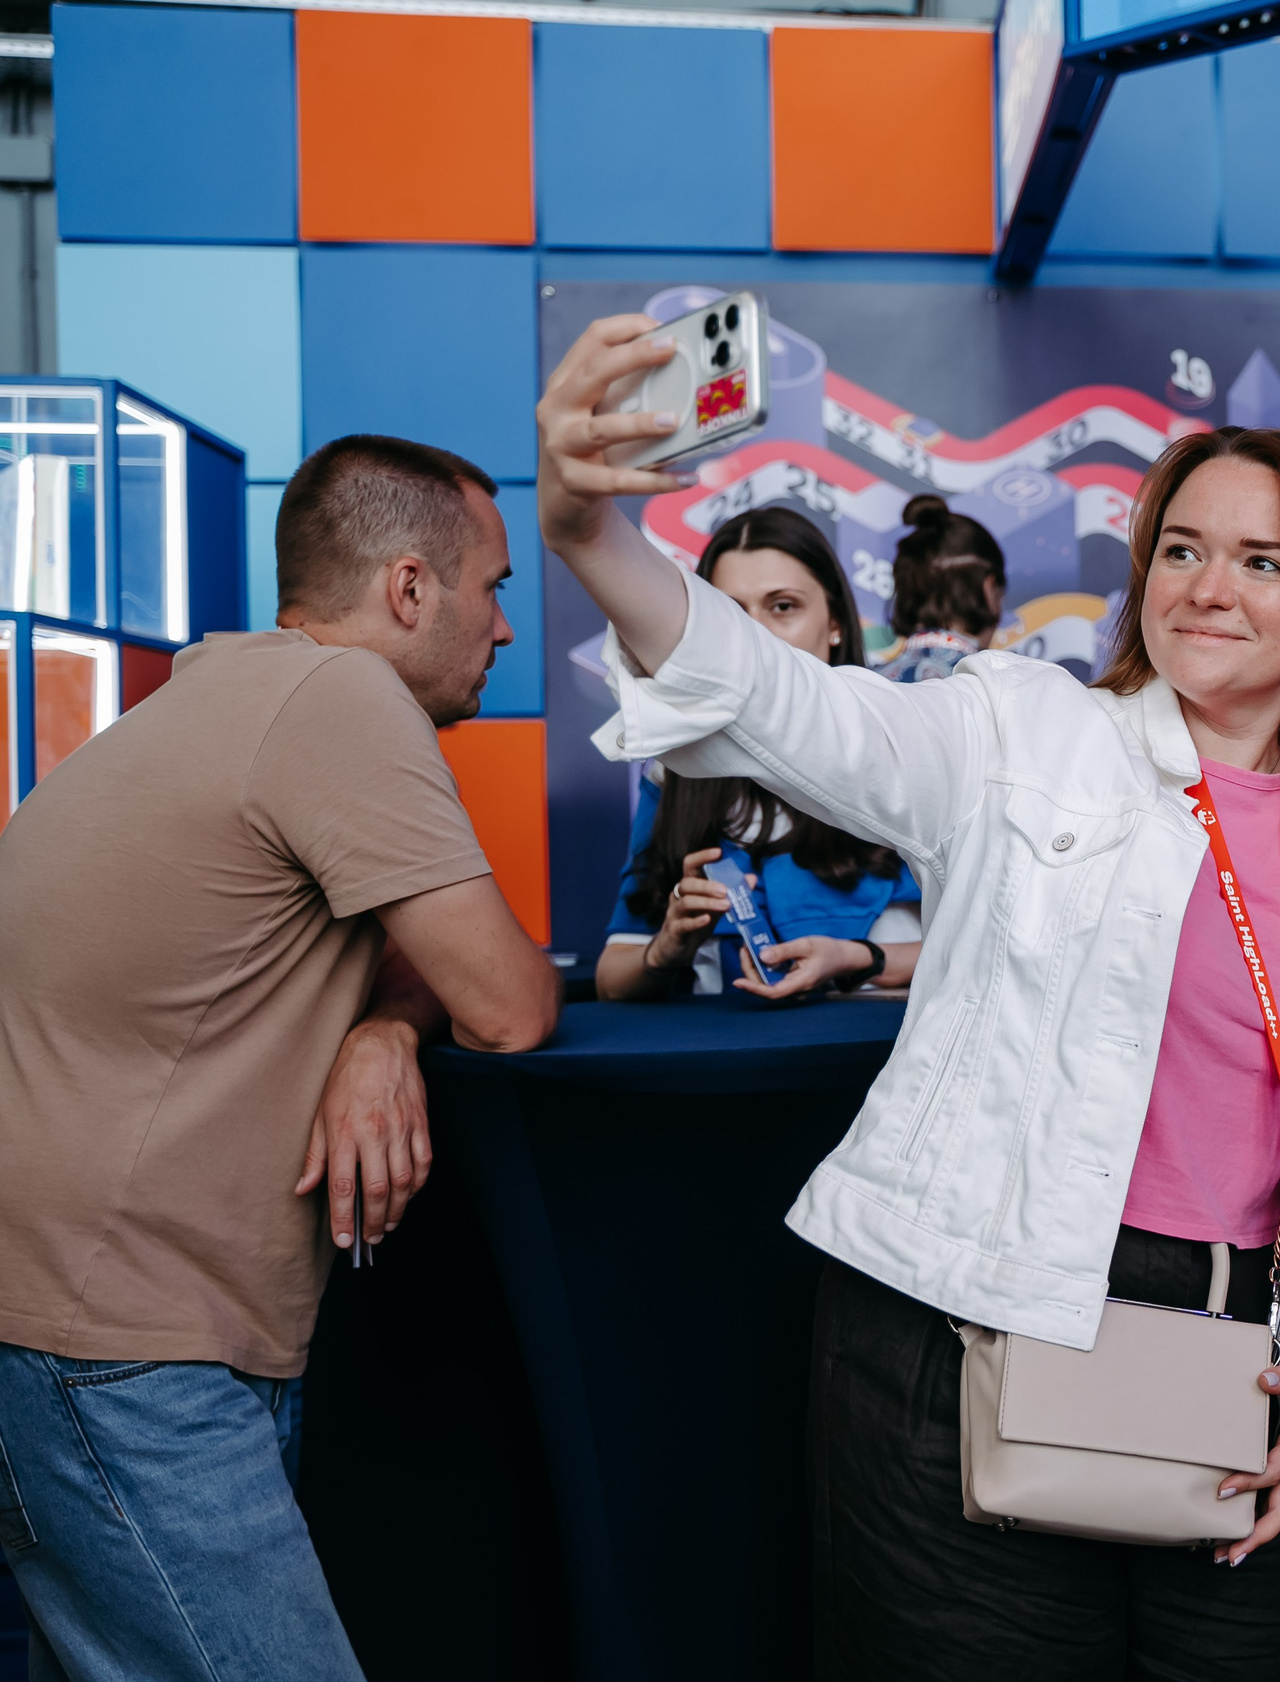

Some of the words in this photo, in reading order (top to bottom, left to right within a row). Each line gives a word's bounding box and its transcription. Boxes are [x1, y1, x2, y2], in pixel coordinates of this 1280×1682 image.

[1169, 349, 1214, 399] 19
[1220, 869, 1245, 922] Saint
[1239, 924, 1279, 1040] HighLoad++
